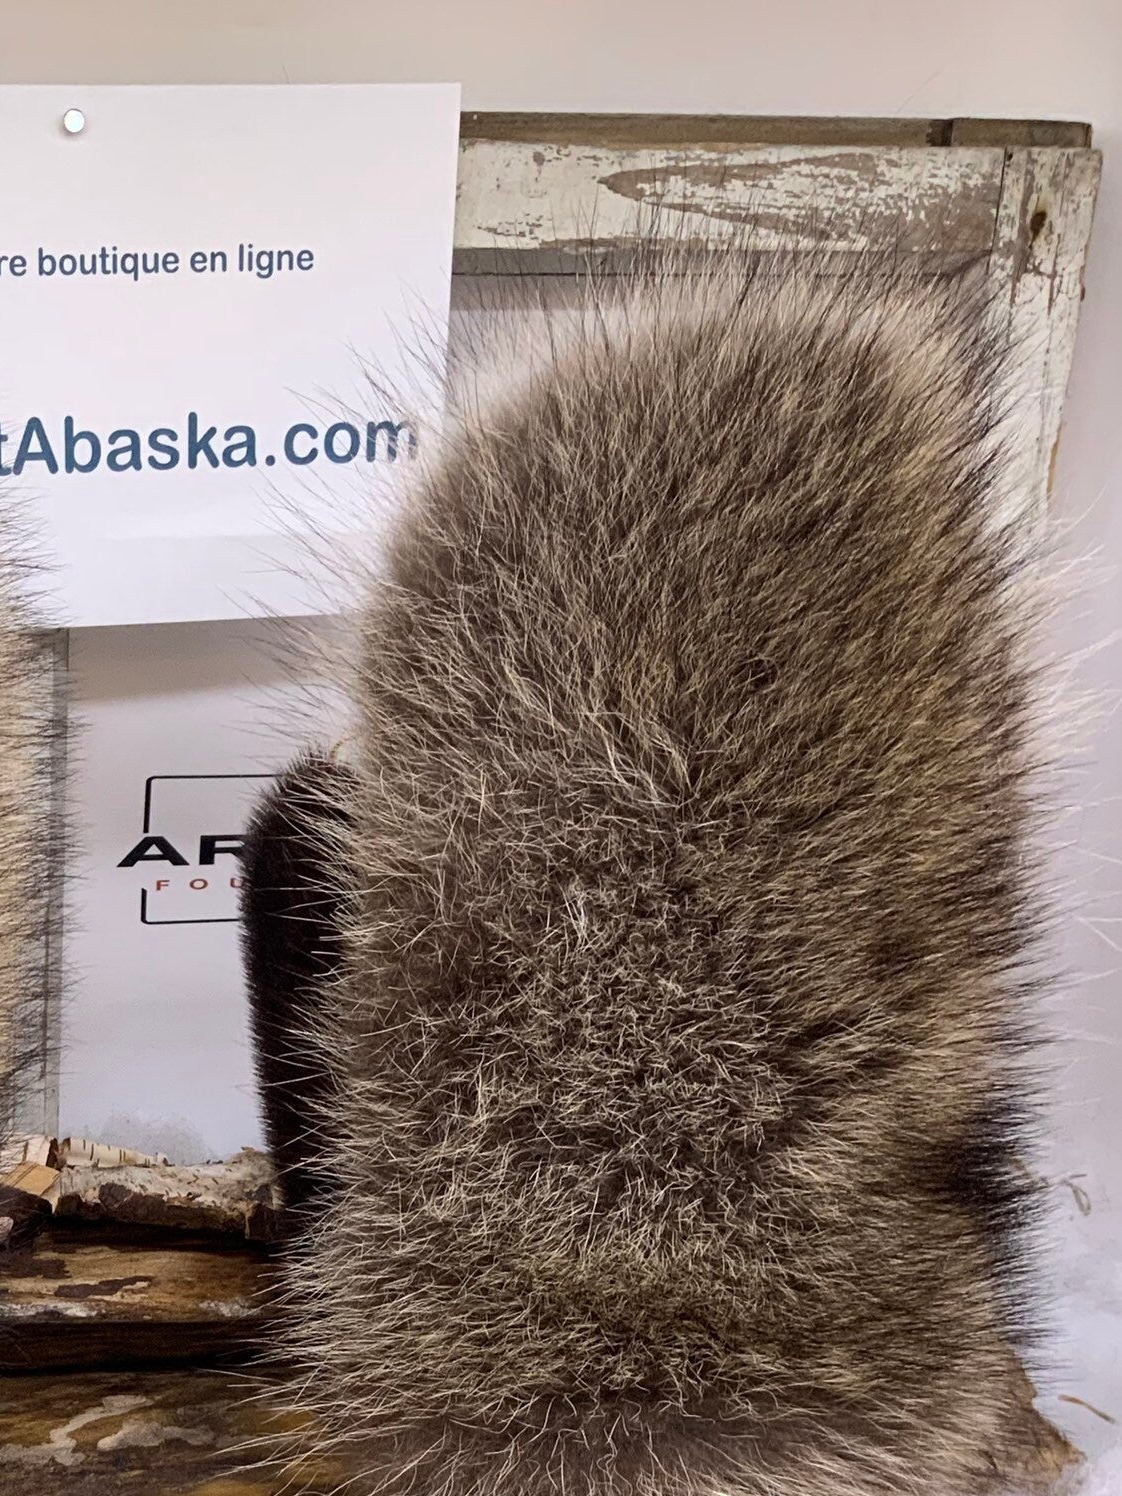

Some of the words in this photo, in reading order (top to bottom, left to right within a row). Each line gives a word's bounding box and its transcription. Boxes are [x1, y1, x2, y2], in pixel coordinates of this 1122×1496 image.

[37, 246, 180, 281] boutique
[189, 250, 228, 273] en
[237, 244, 315, 280] ligne
